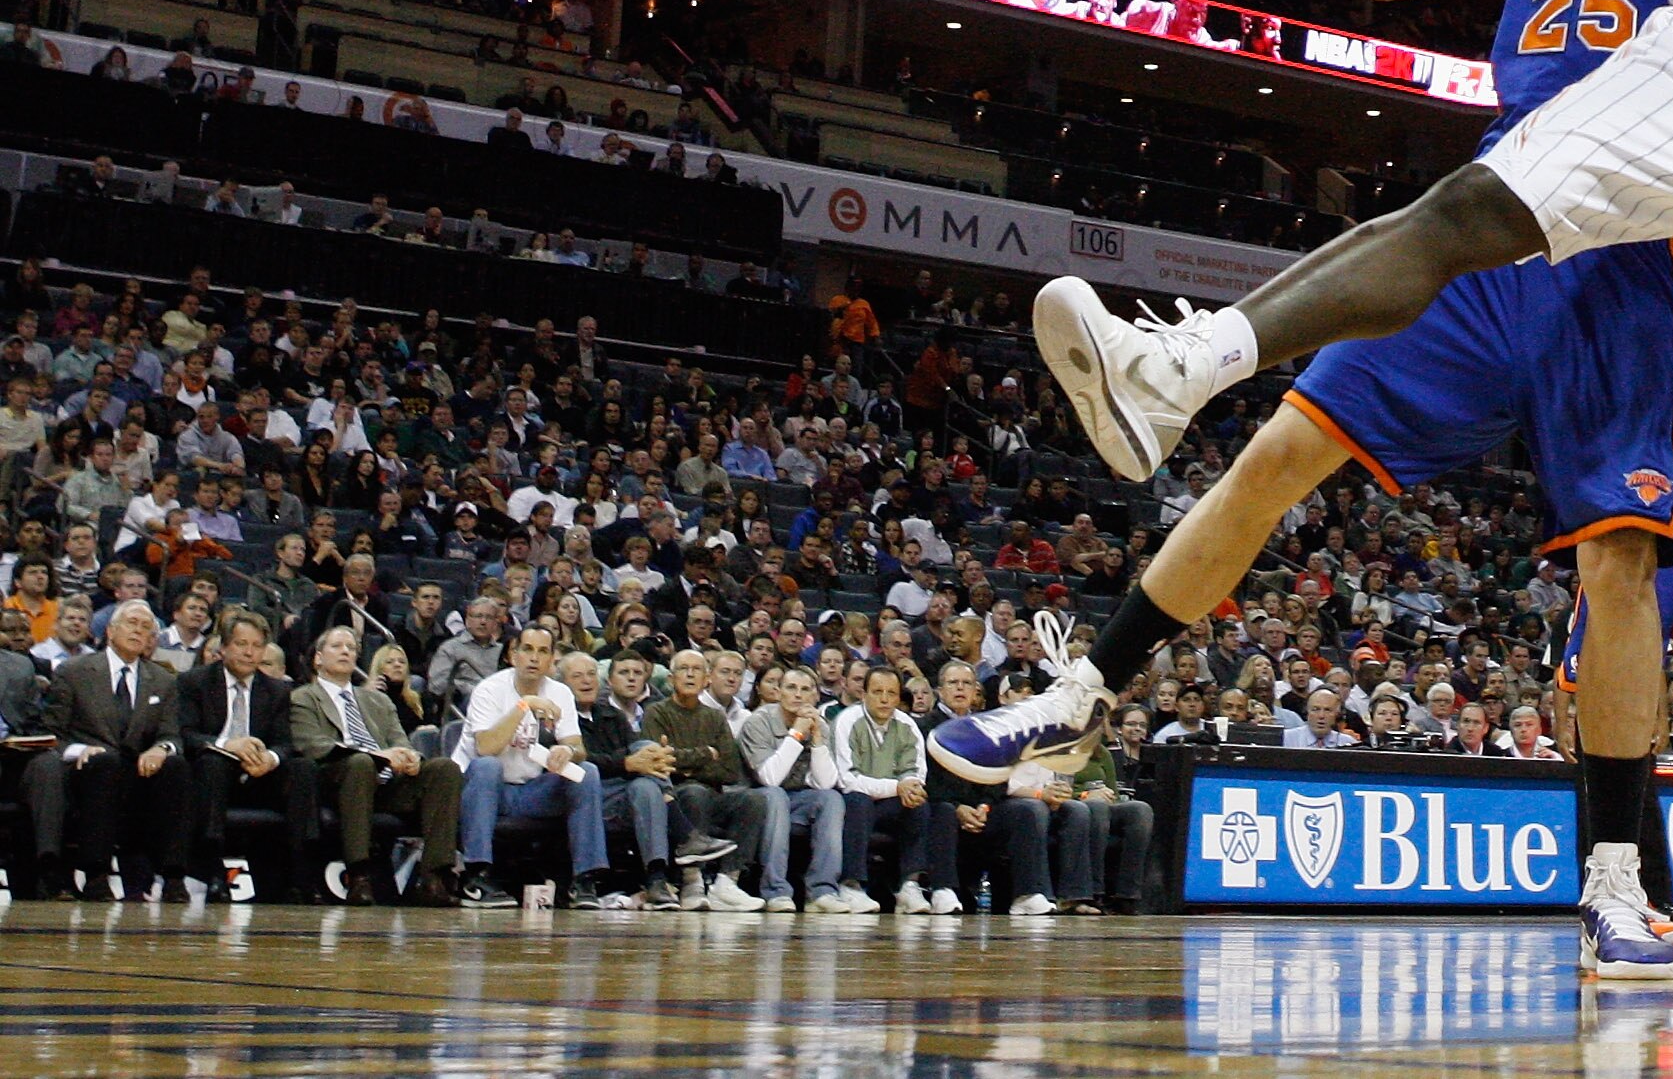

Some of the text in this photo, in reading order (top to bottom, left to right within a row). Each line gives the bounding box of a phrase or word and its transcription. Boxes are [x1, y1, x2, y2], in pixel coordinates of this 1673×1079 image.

[1304, 29, 1368, 72] NBA
[1076, 227, 1118, 256] 106
[1354, 790, 1559, 893] Blue
